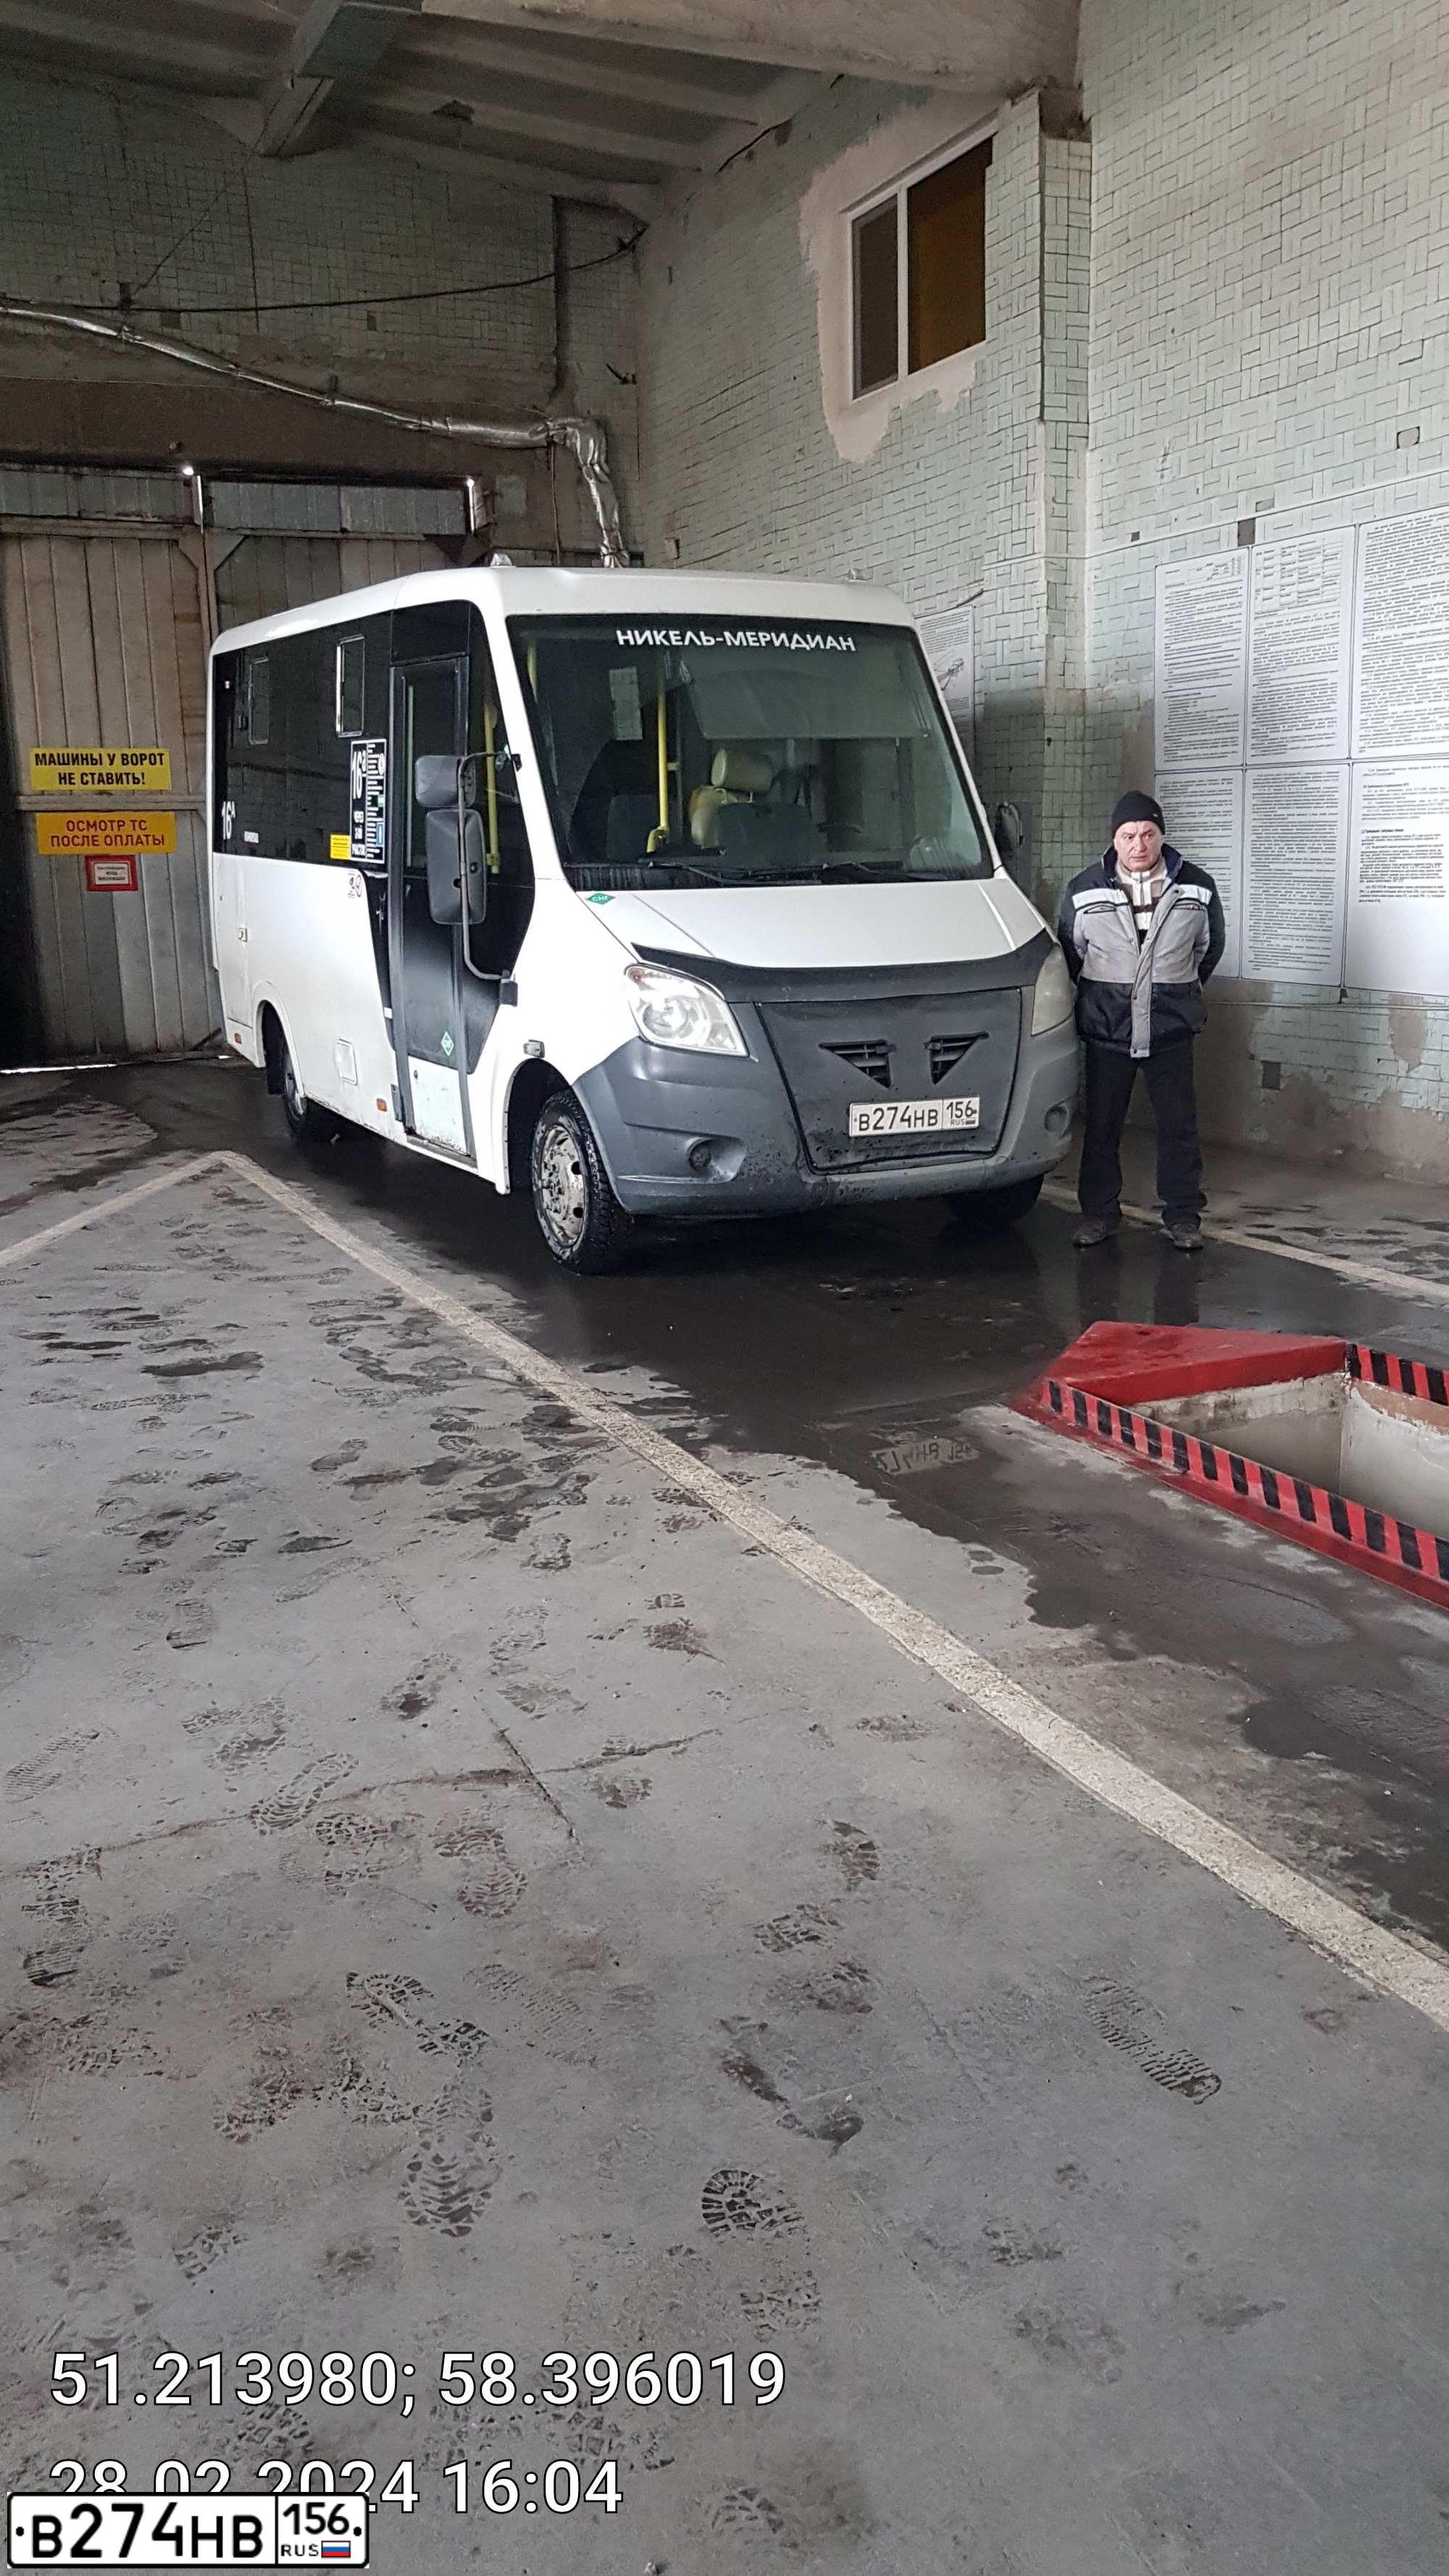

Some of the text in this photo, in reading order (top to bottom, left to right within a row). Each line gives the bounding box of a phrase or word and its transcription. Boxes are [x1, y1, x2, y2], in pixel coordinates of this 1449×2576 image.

[616, 630, 856, 651] НИКЕЛЬ-МЕРИДИАН
[35, 753, 164, 766] МАШИНЫ У ВОРОТ
[58, 772, 146, 785] НЕ СТАВИТЬ!
[66, 819, 148, 833] ОСМОТР ТС
[50, 834, 165, 847] ПОСЛЕ ОПЛАТЫ
[858, 1100, 974, 1132] В274НВ 156
